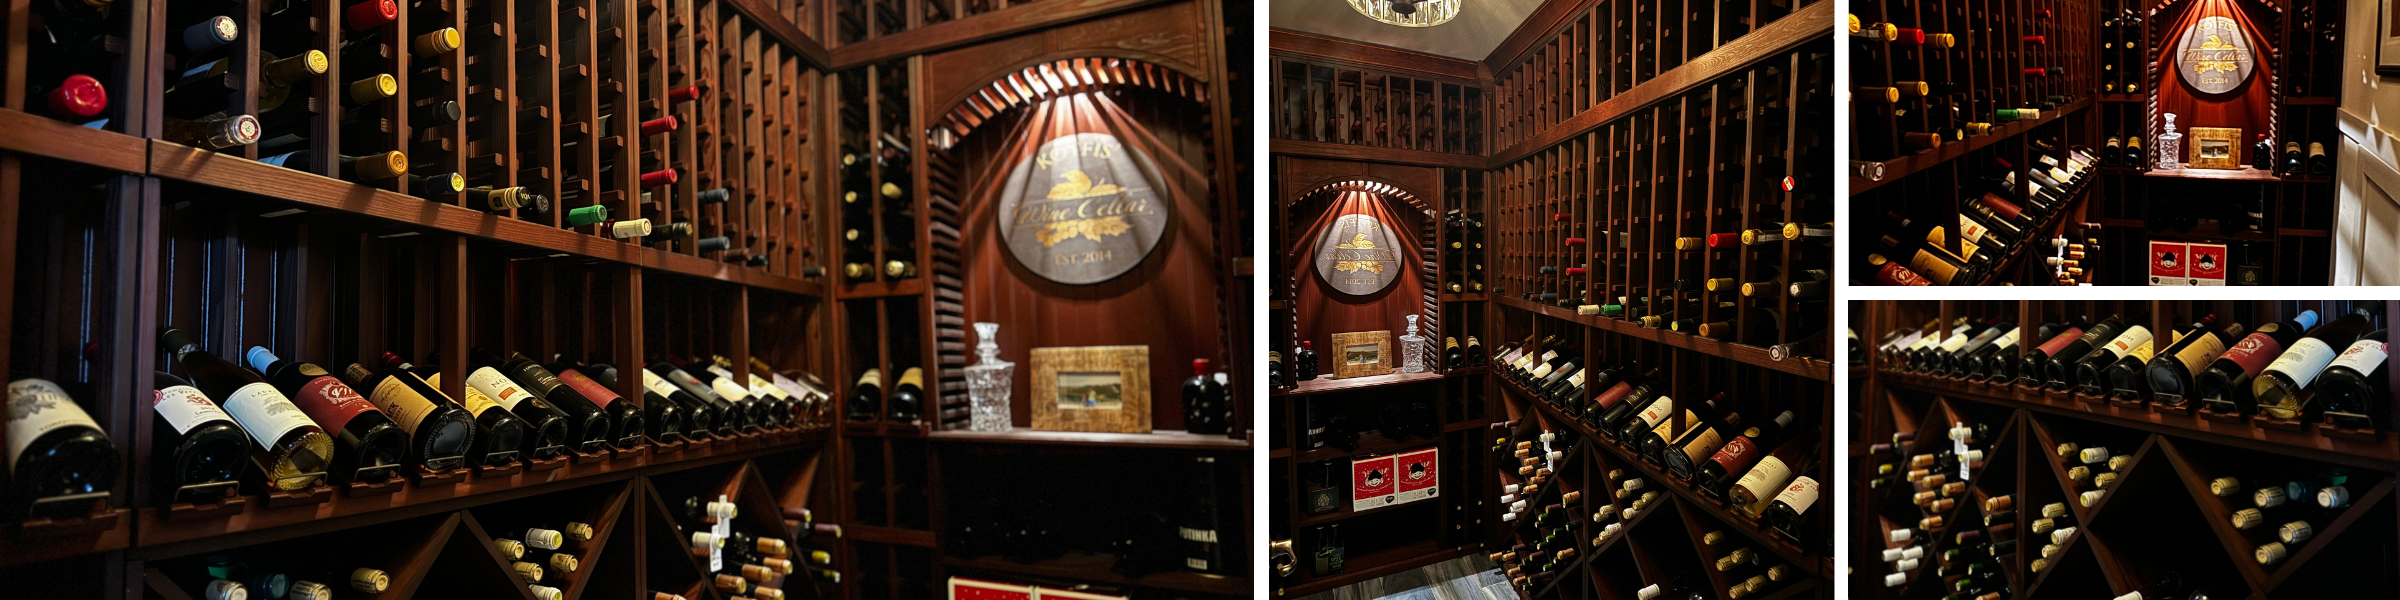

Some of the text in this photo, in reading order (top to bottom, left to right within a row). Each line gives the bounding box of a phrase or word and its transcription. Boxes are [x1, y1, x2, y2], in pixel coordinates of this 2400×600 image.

[2183, 49, 2247, 61] Wine Cellar
[1013, 191, 1149, 225] Wine Cellar
[1083, 250, 1113, 264] 2014
